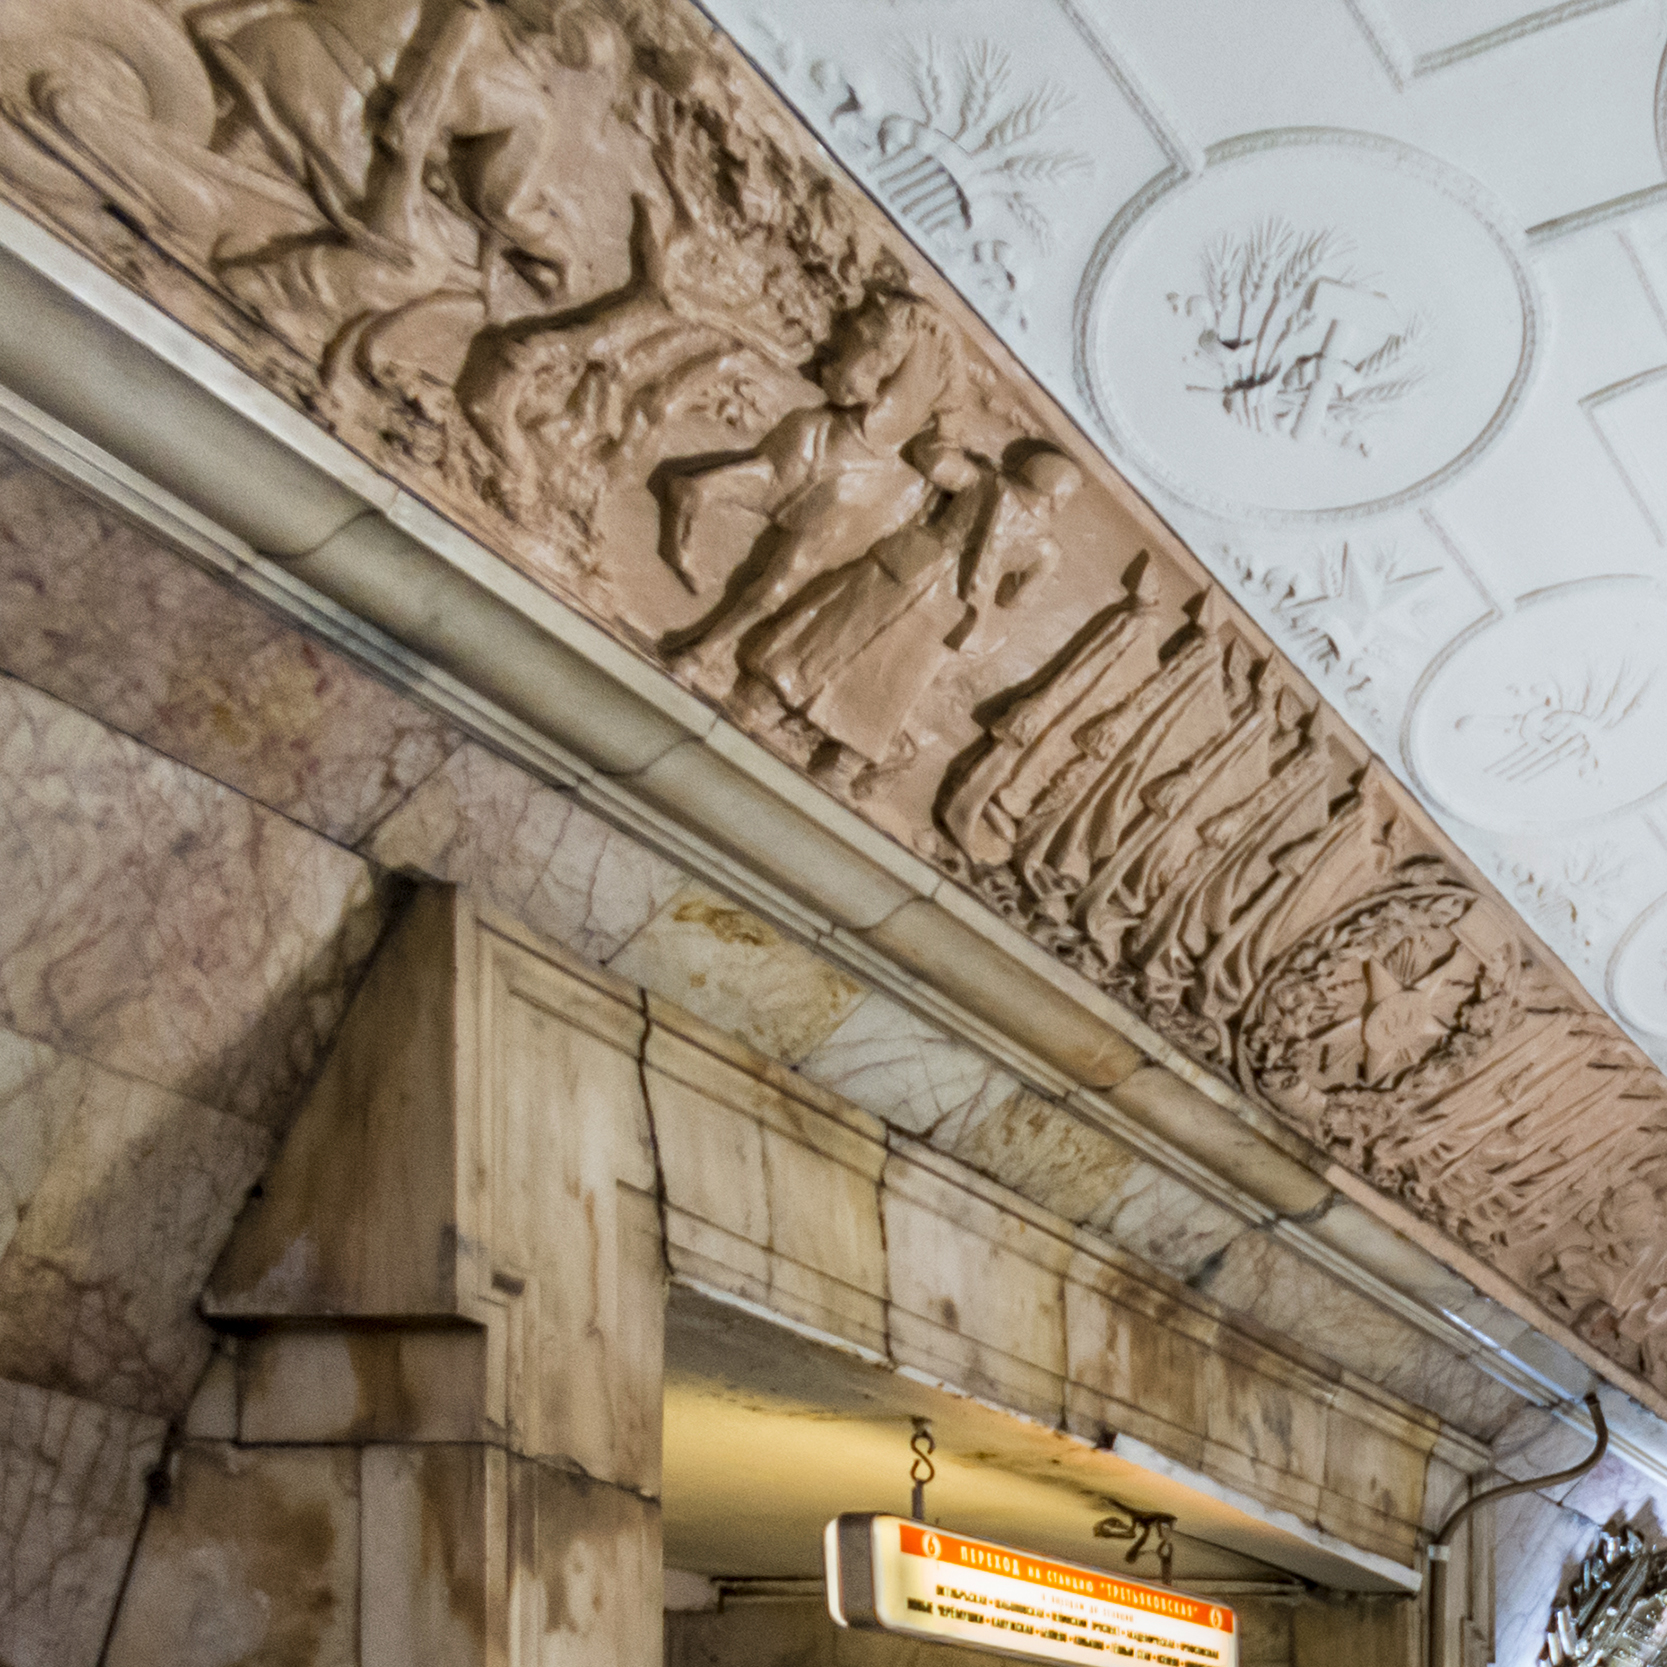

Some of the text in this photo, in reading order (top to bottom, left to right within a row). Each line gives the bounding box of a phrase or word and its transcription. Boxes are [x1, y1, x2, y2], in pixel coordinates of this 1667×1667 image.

[960, 1546, 1020, 1576] ПЕРЕХОД
[1028, 1566, 1041, 1579] НА
[1047, 1571, 1093, 1593] СТАНЦИЮ
